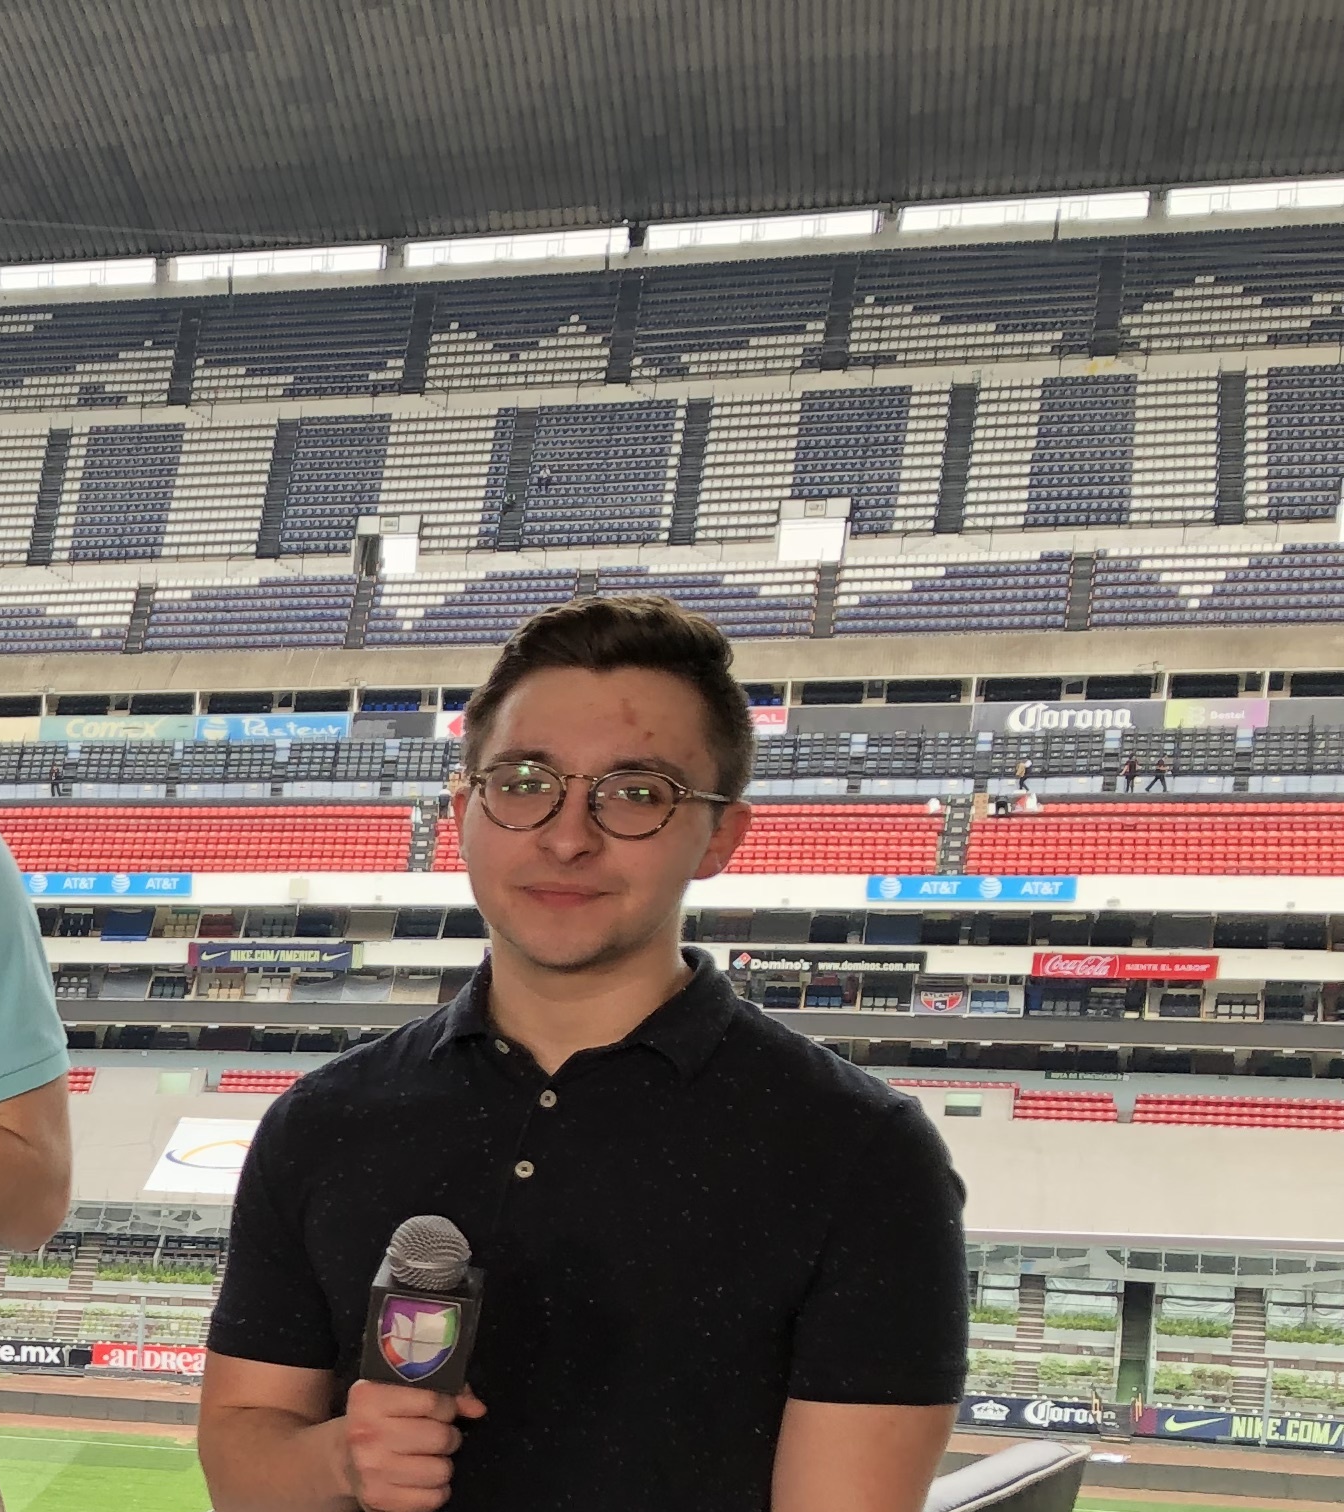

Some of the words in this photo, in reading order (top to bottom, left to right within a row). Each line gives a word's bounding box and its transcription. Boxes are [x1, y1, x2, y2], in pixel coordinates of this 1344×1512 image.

[1007, 702, 1136, 732] Corona
[243, 717, 342, 737] Pasteur
[63, 877, 96, 890] AT&T
[145, 878, 179, 890] AT&T
[919, 881, 961, 895] AT&T
[1021, 881, 1063, 895] AT&T
[750, 958, 811, 970] Domino's
[818, 960, 920, 972] www.dominos.com.mx
